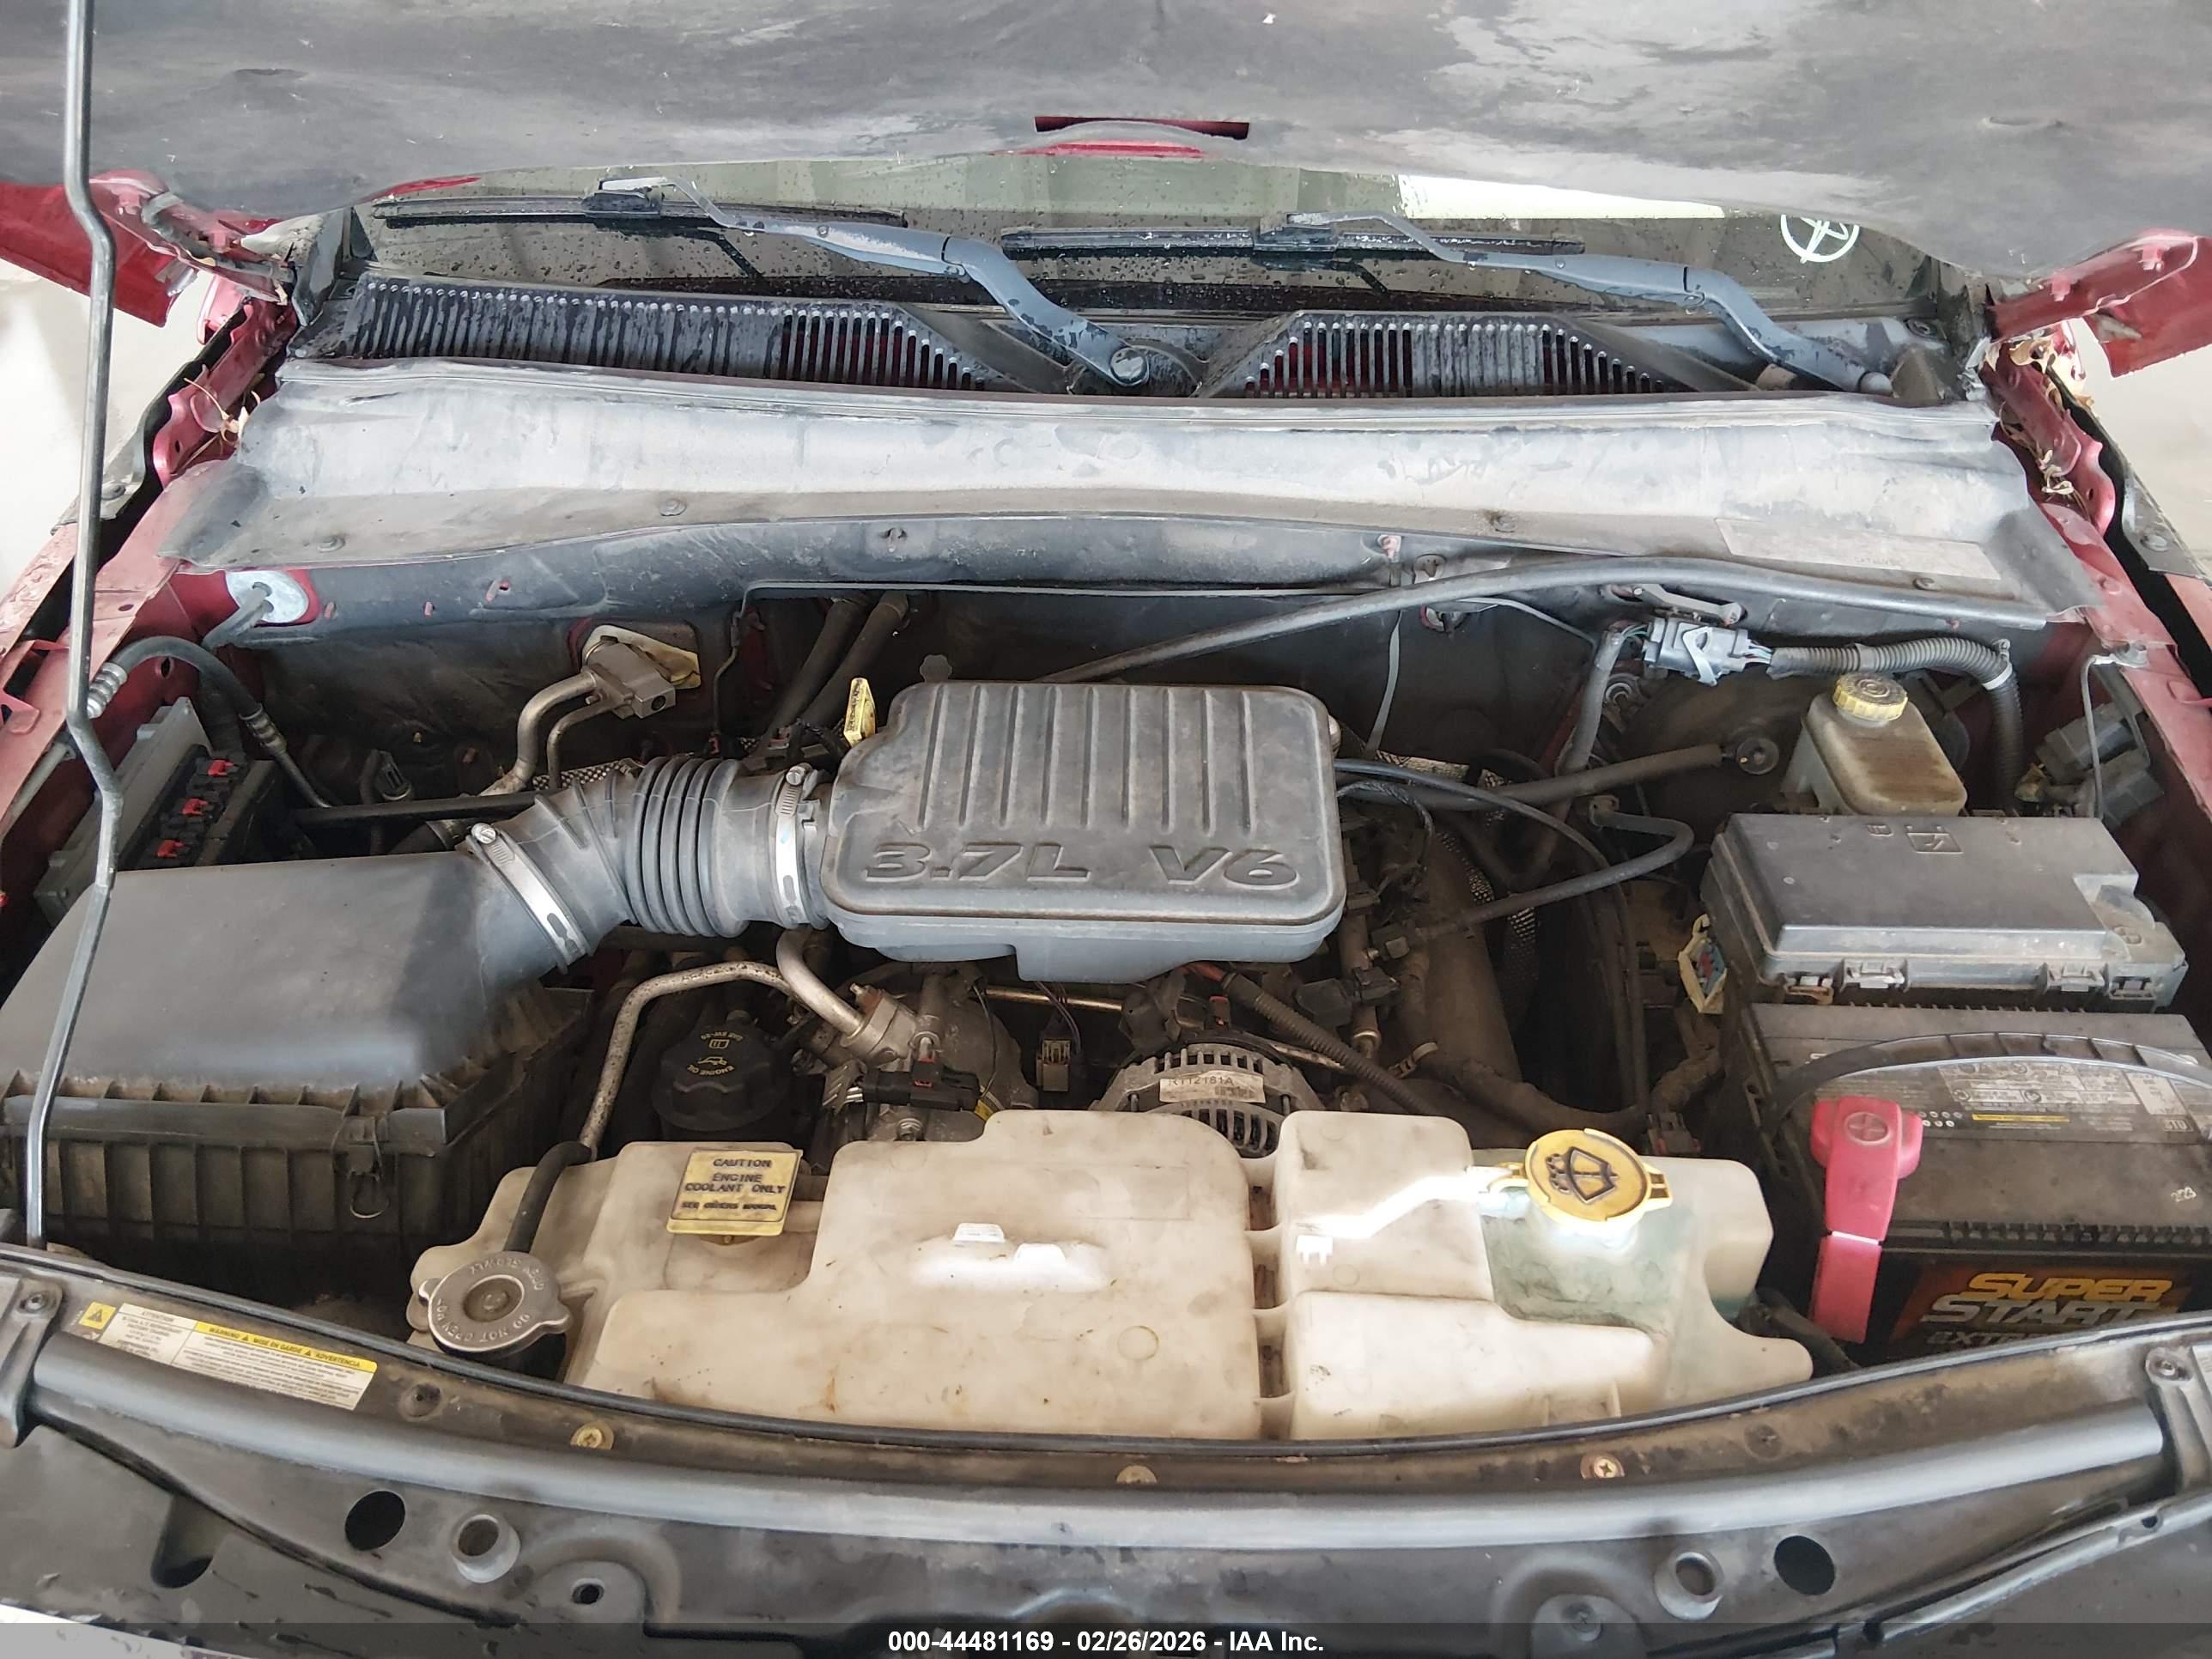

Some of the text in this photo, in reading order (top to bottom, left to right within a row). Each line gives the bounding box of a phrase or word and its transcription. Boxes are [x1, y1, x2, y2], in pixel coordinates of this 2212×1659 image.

[866, 842, 1300, 890] 3.7L V6
[714, 1158, 772, 1168] CAUTION
[685, 1182, 786, 1194] COOLANT ONLY
[713, 1173, 763, 1182] ENGINE
[1961, 1273, 2172, 1302] SUPER
[1921, 1293, 2160, 1326] START
[479, 1327, 509, 1343] NOT
[209, 1327, 361, 1369] WARNING MISE EN GARDE ADVERTENCIA
